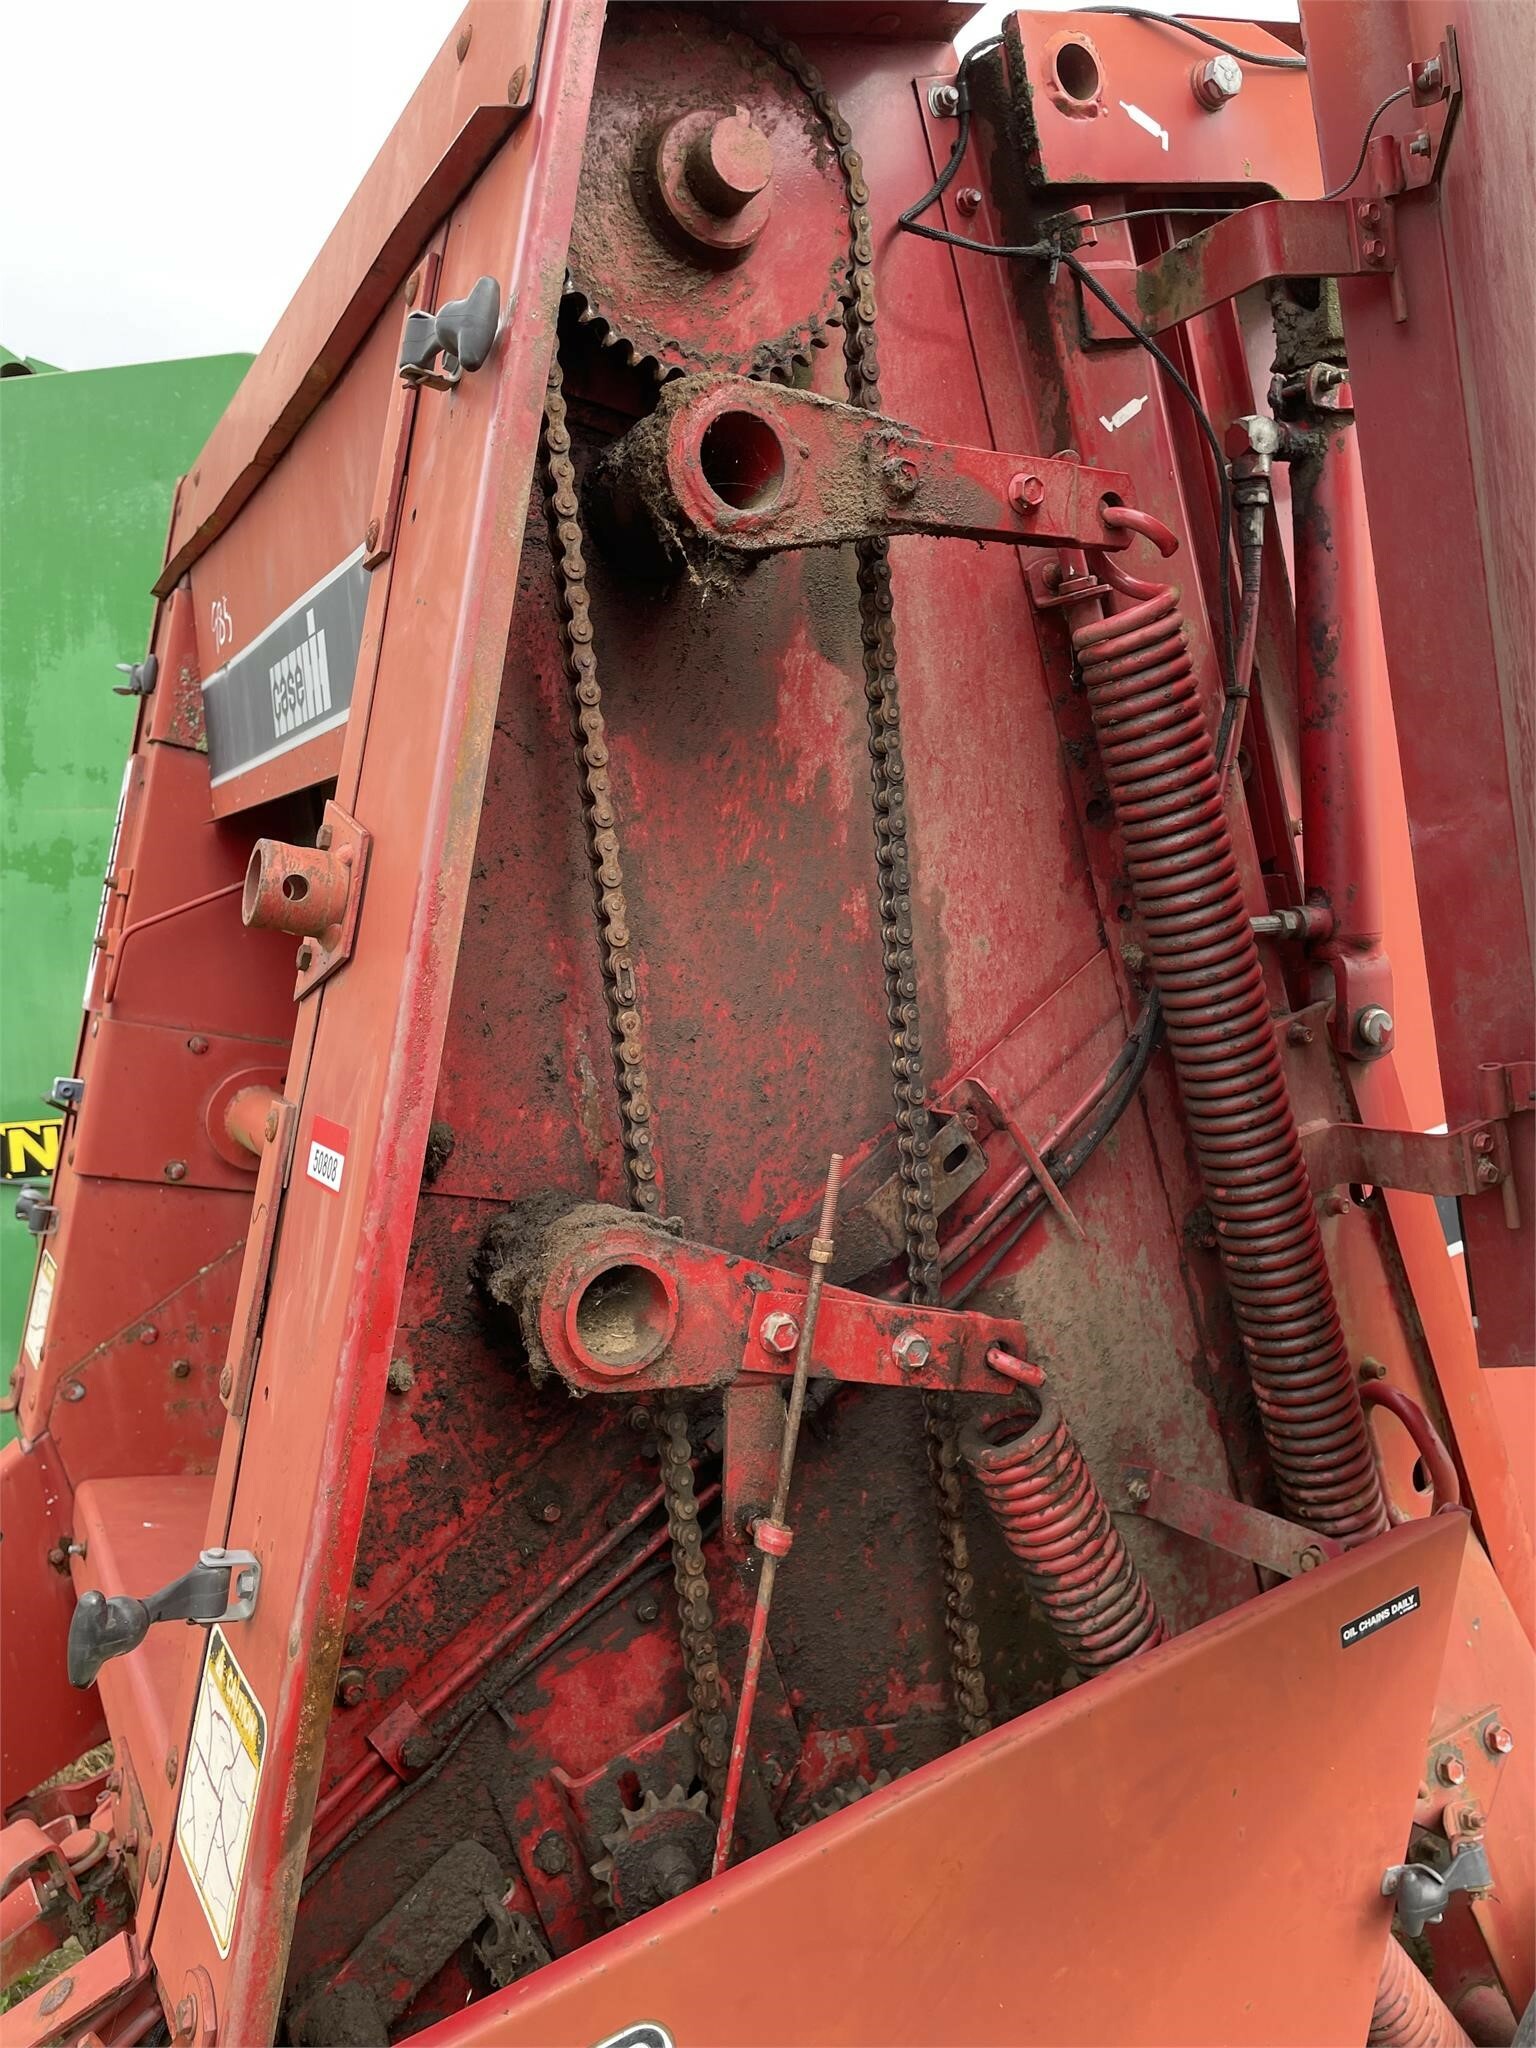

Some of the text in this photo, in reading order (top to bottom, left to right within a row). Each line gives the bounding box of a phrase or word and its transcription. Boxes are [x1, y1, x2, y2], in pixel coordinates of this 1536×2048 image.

[313, 1149, 338, 1182] 50808
[1343, 1626, 1358, 1640] OIL
[1358, 1608, 1391, 1632] CHAINS
[1391, 1594, 1415, 1615] DAILY
